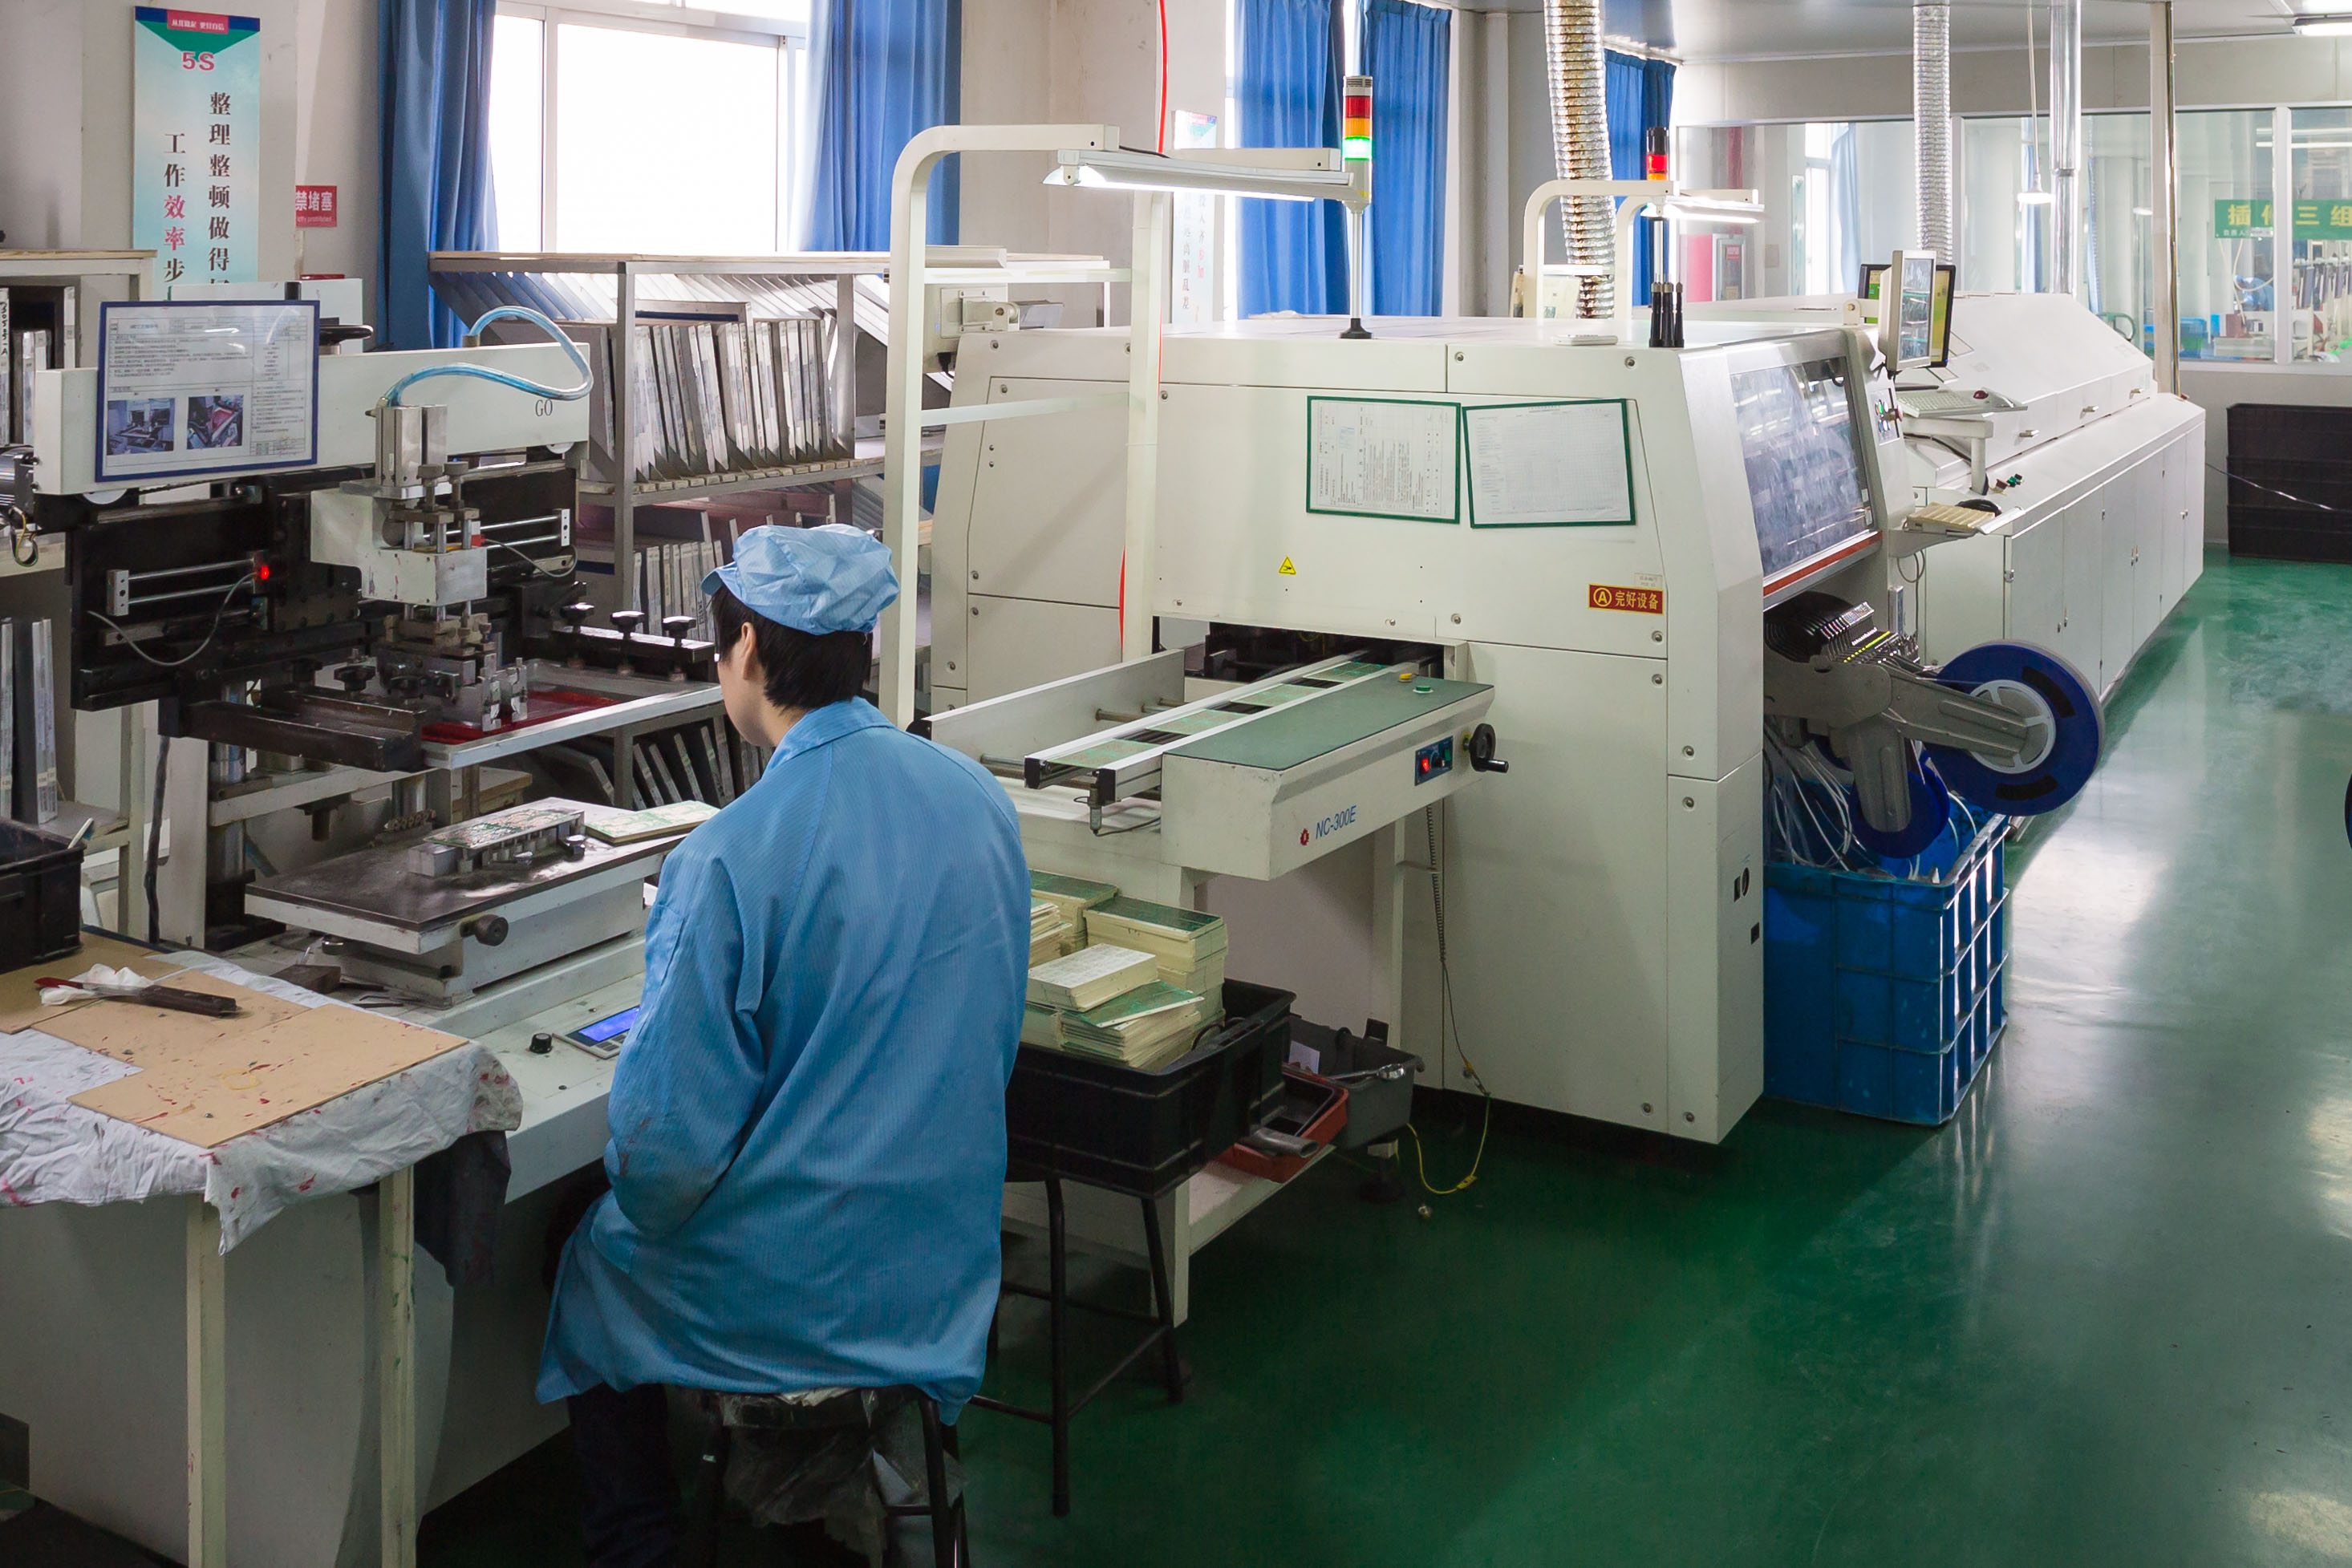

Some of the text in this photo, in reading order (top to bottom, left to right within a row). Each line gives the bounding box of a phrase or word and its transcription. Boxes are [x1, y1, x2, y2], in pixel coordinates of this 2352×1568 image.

[181, 51, 215, 71] 5S
[209, 91, 231, 284] 整理整顿做得
[1615, 590, 1659, 610] 完好设备
[1316, 804, 1357, 840] NC-300E
